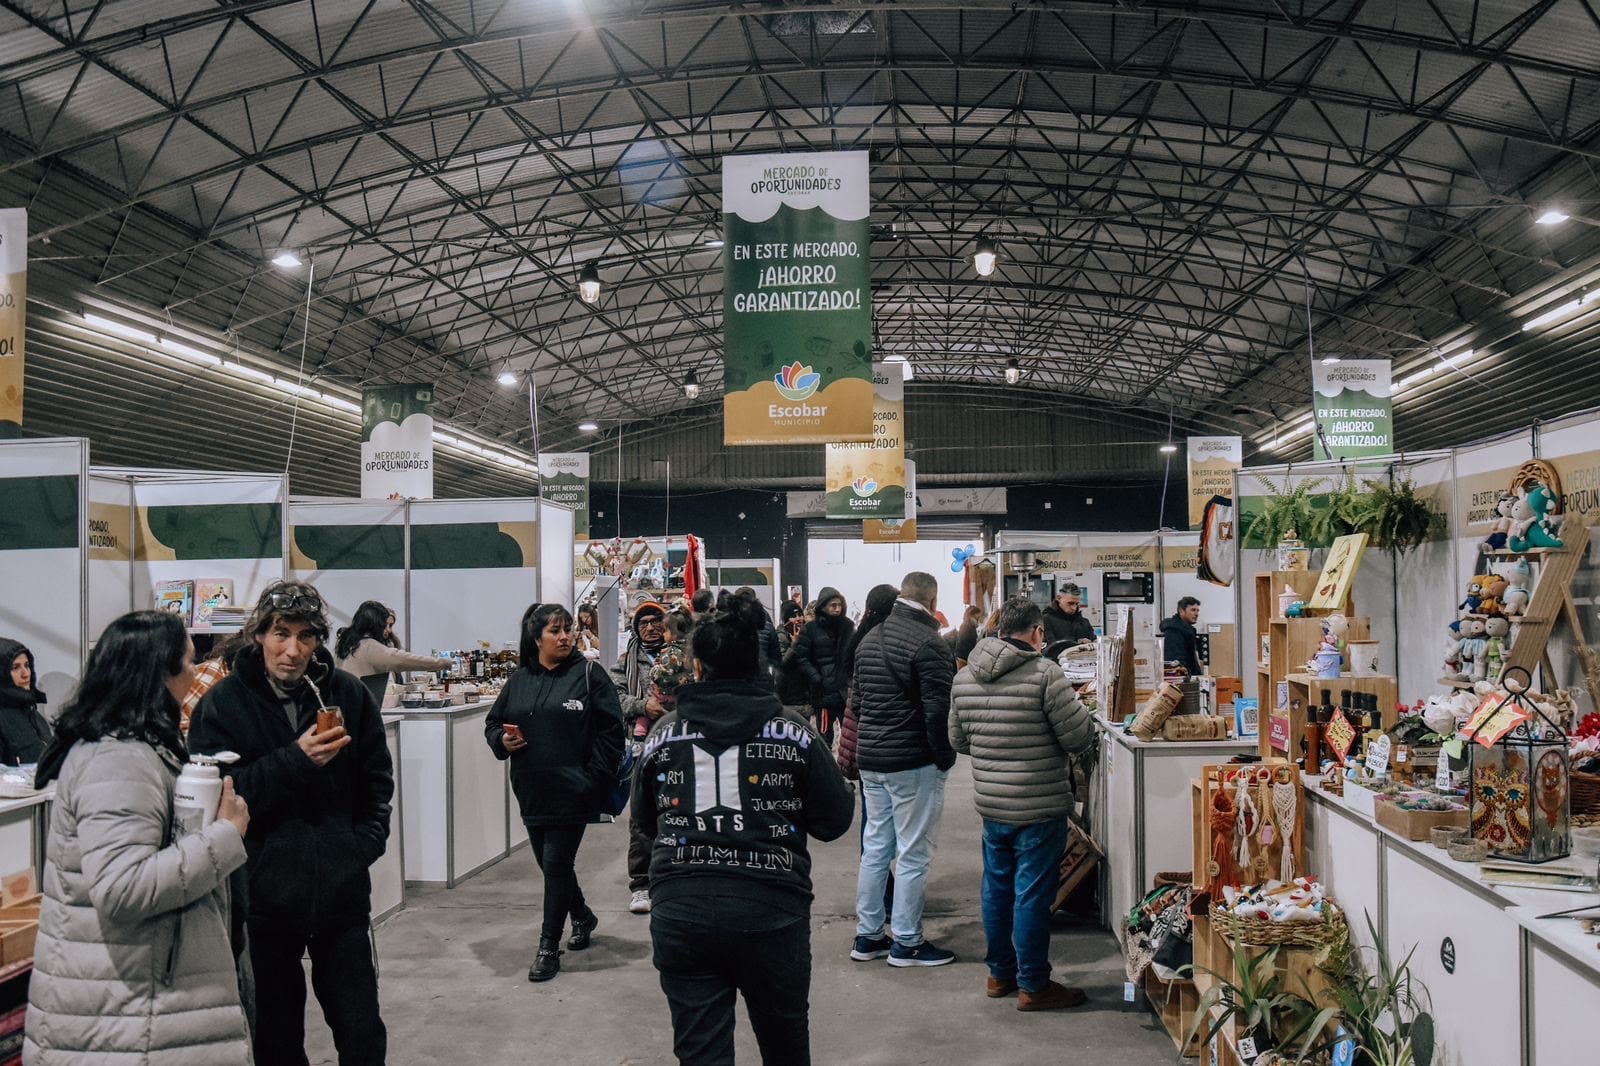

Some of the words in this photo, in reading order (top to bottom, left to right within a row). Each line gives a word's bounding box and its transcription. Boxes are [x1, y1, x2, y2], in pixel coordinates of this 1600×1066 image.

[764, 166, 816, 180] MERCADO
[819, 168, 829, 176] DE
[751, 178, 842, 194] OPORTUNIDADES
[734, 245, 751, 260] EN
[756, 243, 788, 260] ESTE
[793, 241, 860, 258] MERCADO,
[758, 264, 836, 289] ¡AHORRO
[734, 288, 861, 312] GARANTIZADO!
[1326, 374, 1376, 382] OPORTUNIDADES
[768, 403, 828, 418] Escobar
[874, 412, 898, 421] RCADO,
[1318, 409, 1328, 418] EN
[1330, 408, 1349, 418] ESTE
[774, 418, 820, 426] MUNICIPIO
[1332, 421, 1374, 434] ¡AHORRO
[374, 450, 411, 460] MERCADO
[366, 460, 429, 472] OPORTUNIDADES
[850, 498, 882, 506] Escobar
[89, 535, 118, 548] NTIZADO!
[668, 770, 684, 784] RM
[769, 824, 788, 837] TAE
